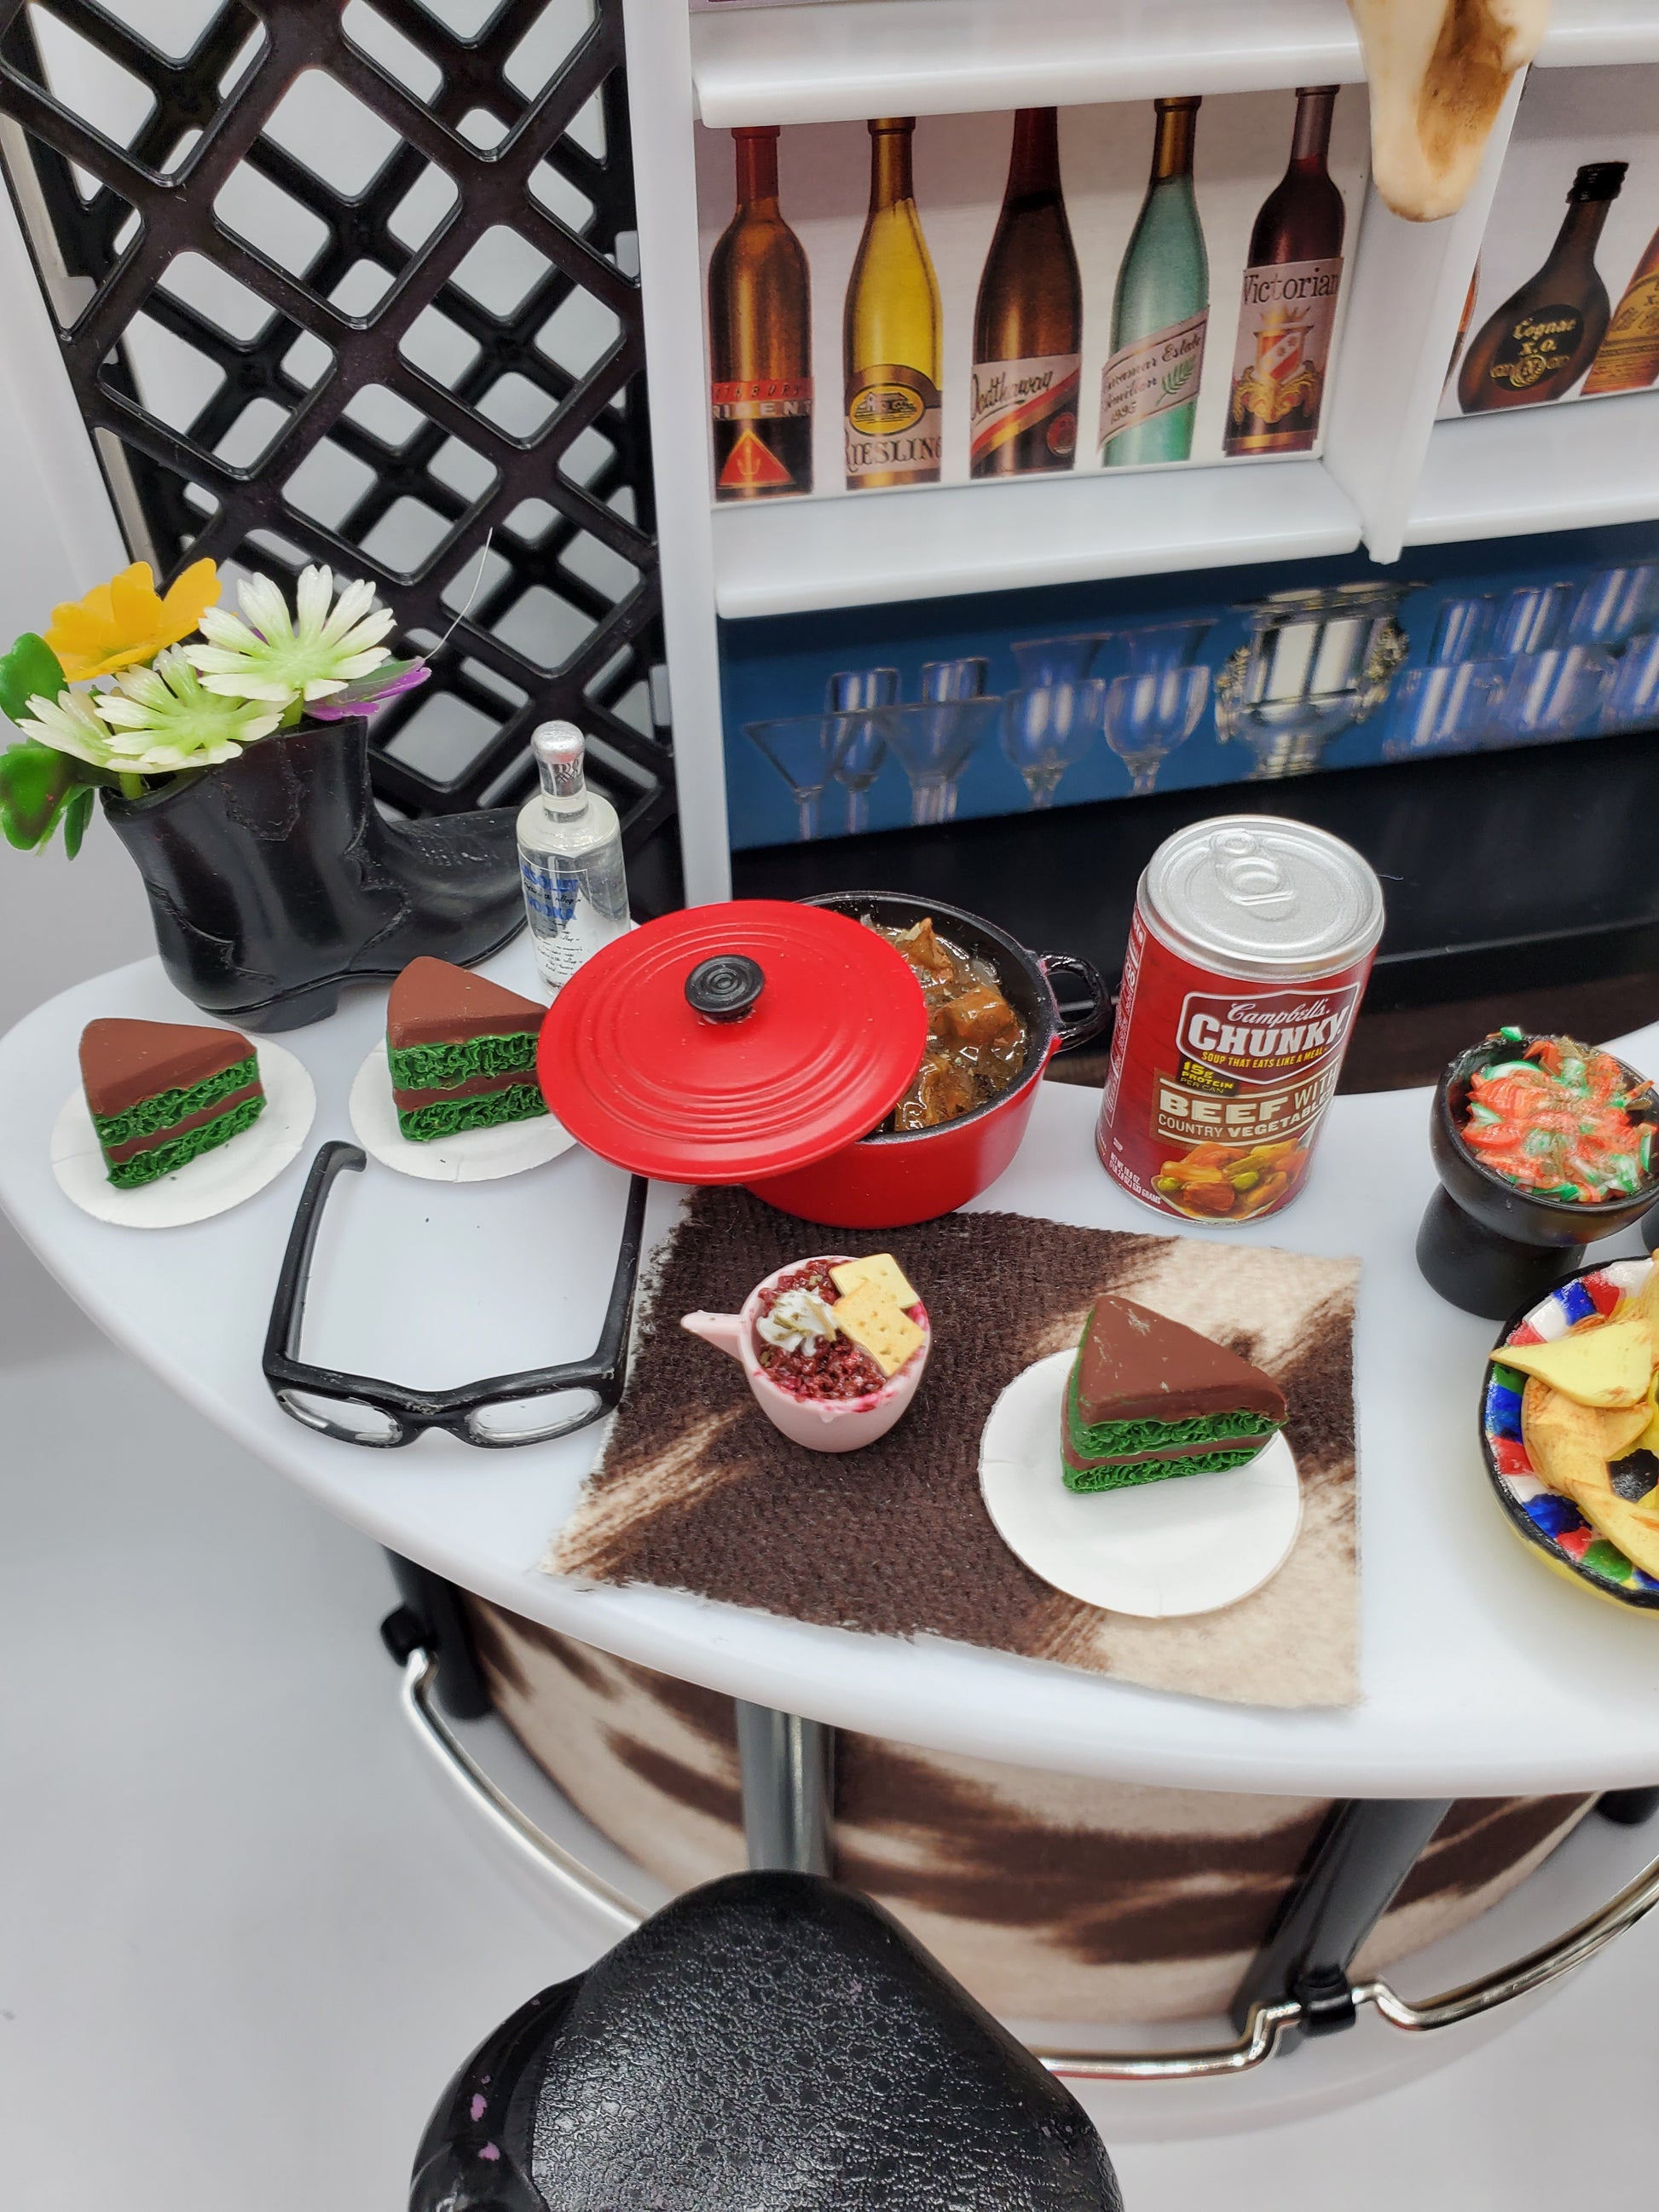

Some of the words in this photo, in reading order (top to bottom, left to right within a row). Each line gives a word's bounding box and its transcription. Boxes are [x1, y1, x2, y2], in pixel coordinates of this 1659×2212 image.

[1243, 268, 1338, 304] Victorian
[1512, 318, 1576, 341] Cognac
[1201, 1050, 1226, 1065] SOUP
[1228, 1056, 1250, 1068] THAT
[1252, 1058, 1275, 1069] EATS
[1276, 1054, 1295, 1066] LIKE
[1296, 1054, 1303, 1064] A
[1304, 1046, 1324, 1061] MEAL
[1181, 1071, 1234, 1089] PROTEIN
[1183, 1060, 1215, 1080] 15g
[1159, 1089, 1288, 1124] BEEF
[1293, 1062, 1338, 1110] WITH
[1180, 1077, 1199, 1089] PER
[1201, 1083, 1225, 1094] CAN
[1158, 1113, 1228, 1138] COUNTRY
[1141, 1188, 1161, 1204] GRAMS
